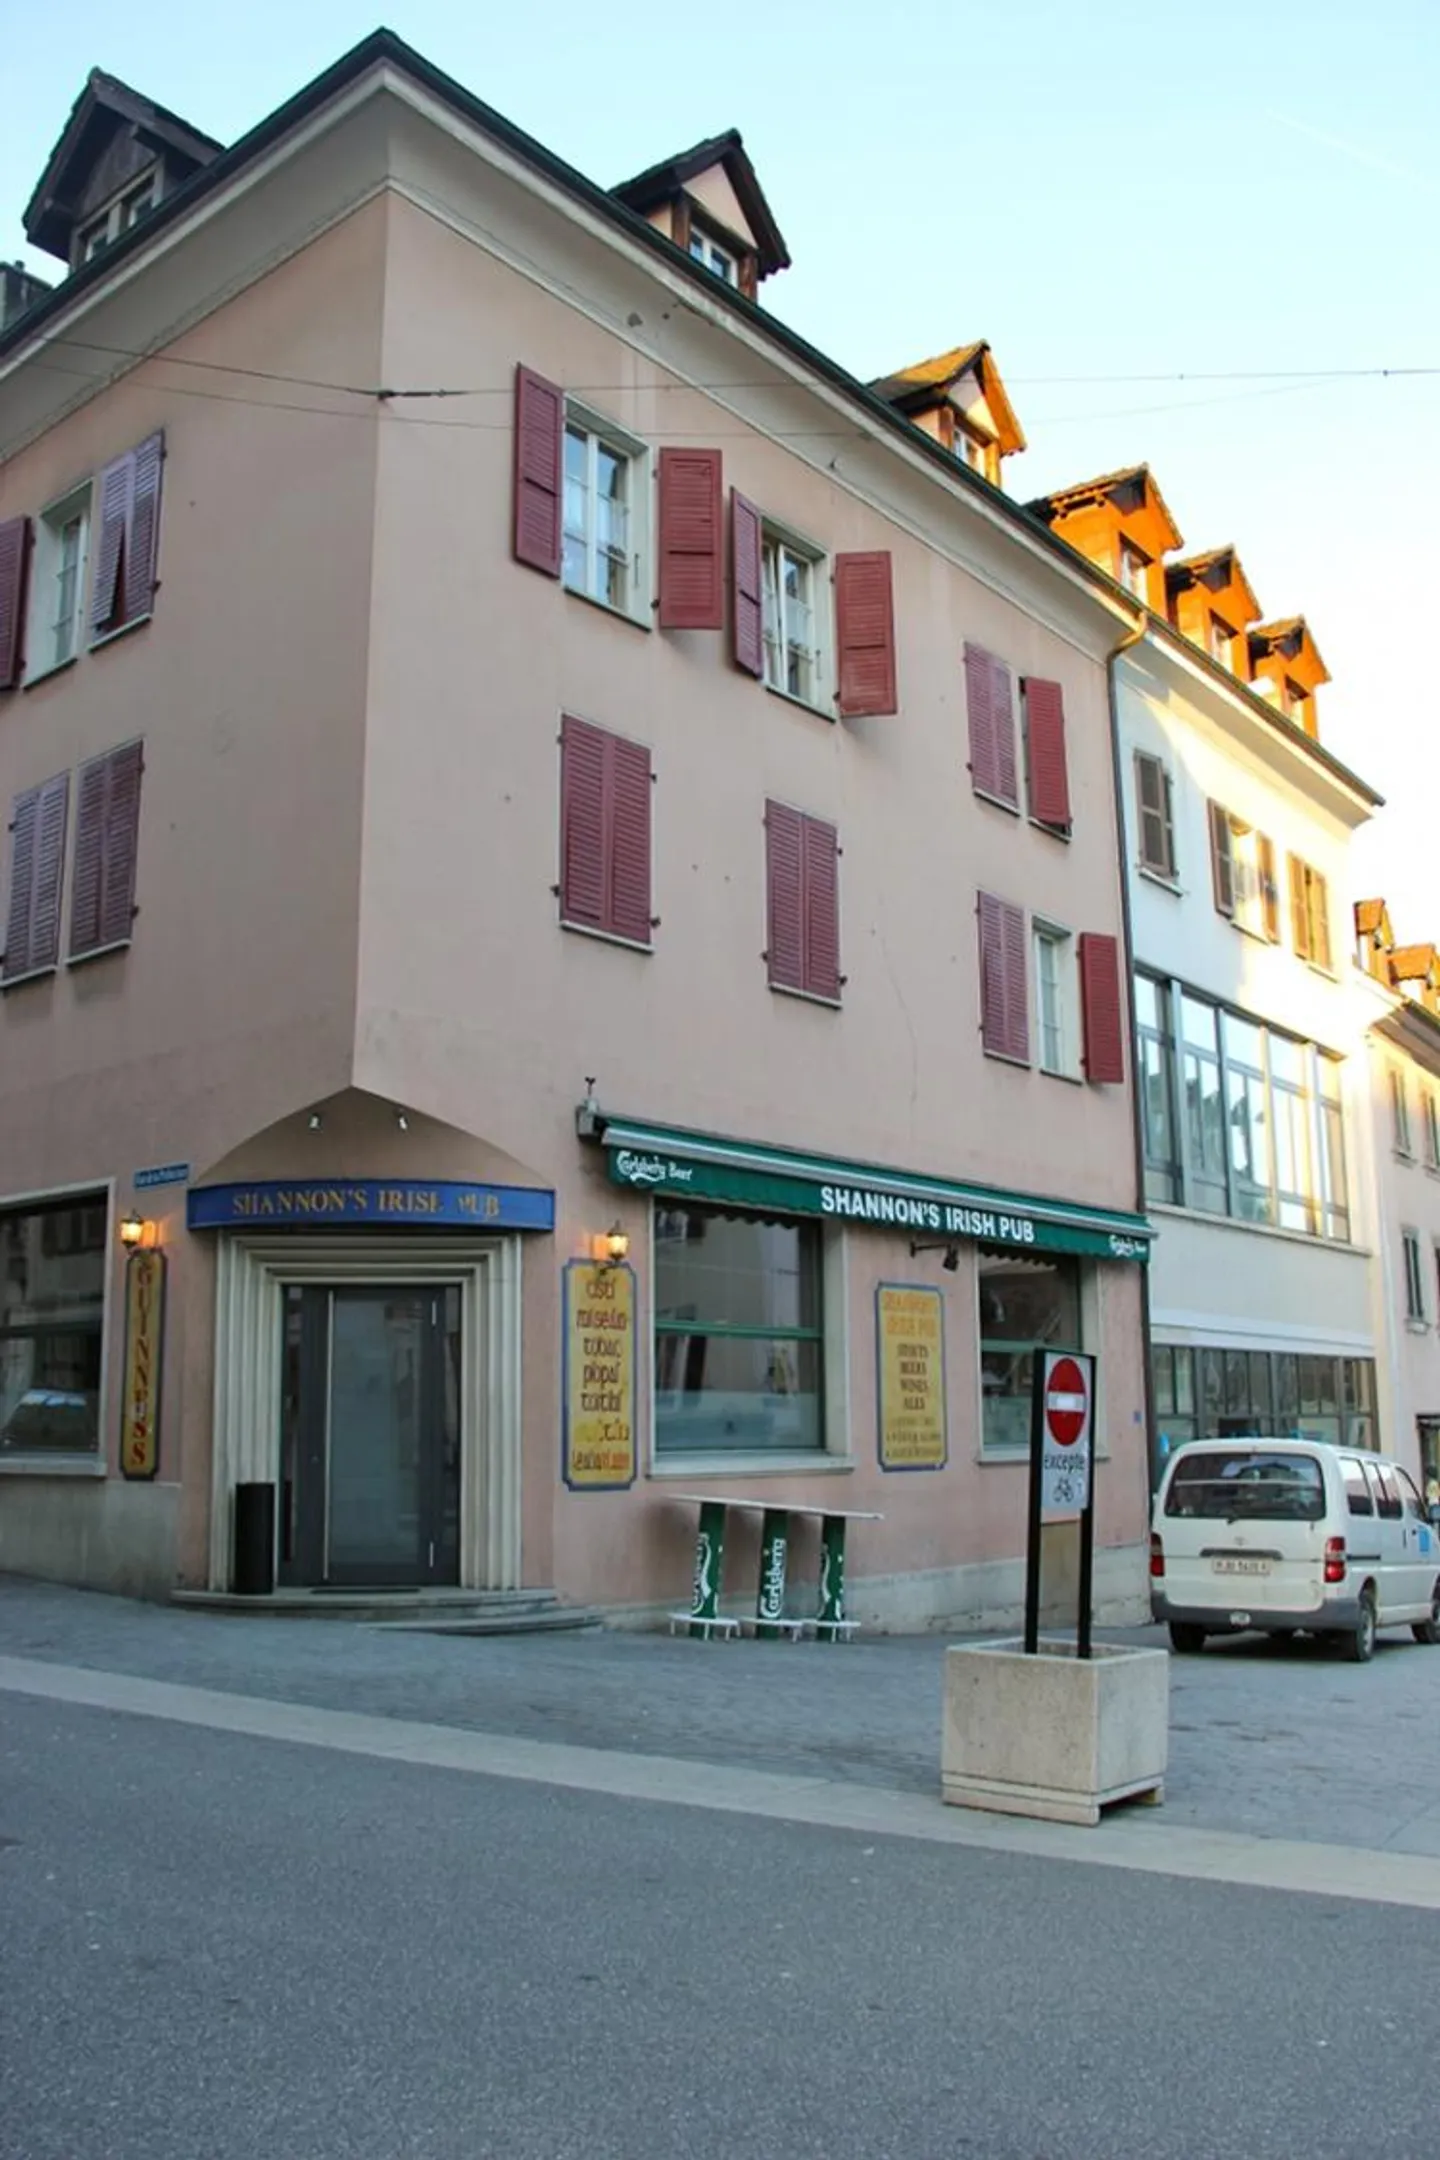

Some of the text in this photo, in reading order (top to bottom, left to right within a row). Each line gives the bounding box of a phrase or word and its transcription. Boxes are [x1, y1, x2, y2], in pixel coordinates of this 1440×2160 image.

[232, 1187, 367, 1216] SHANNON'S
[820, 1186, 1035, 1243] SHANNON'S IRISH PUB
[760, 1537, 787, 1619] Carlsberg
